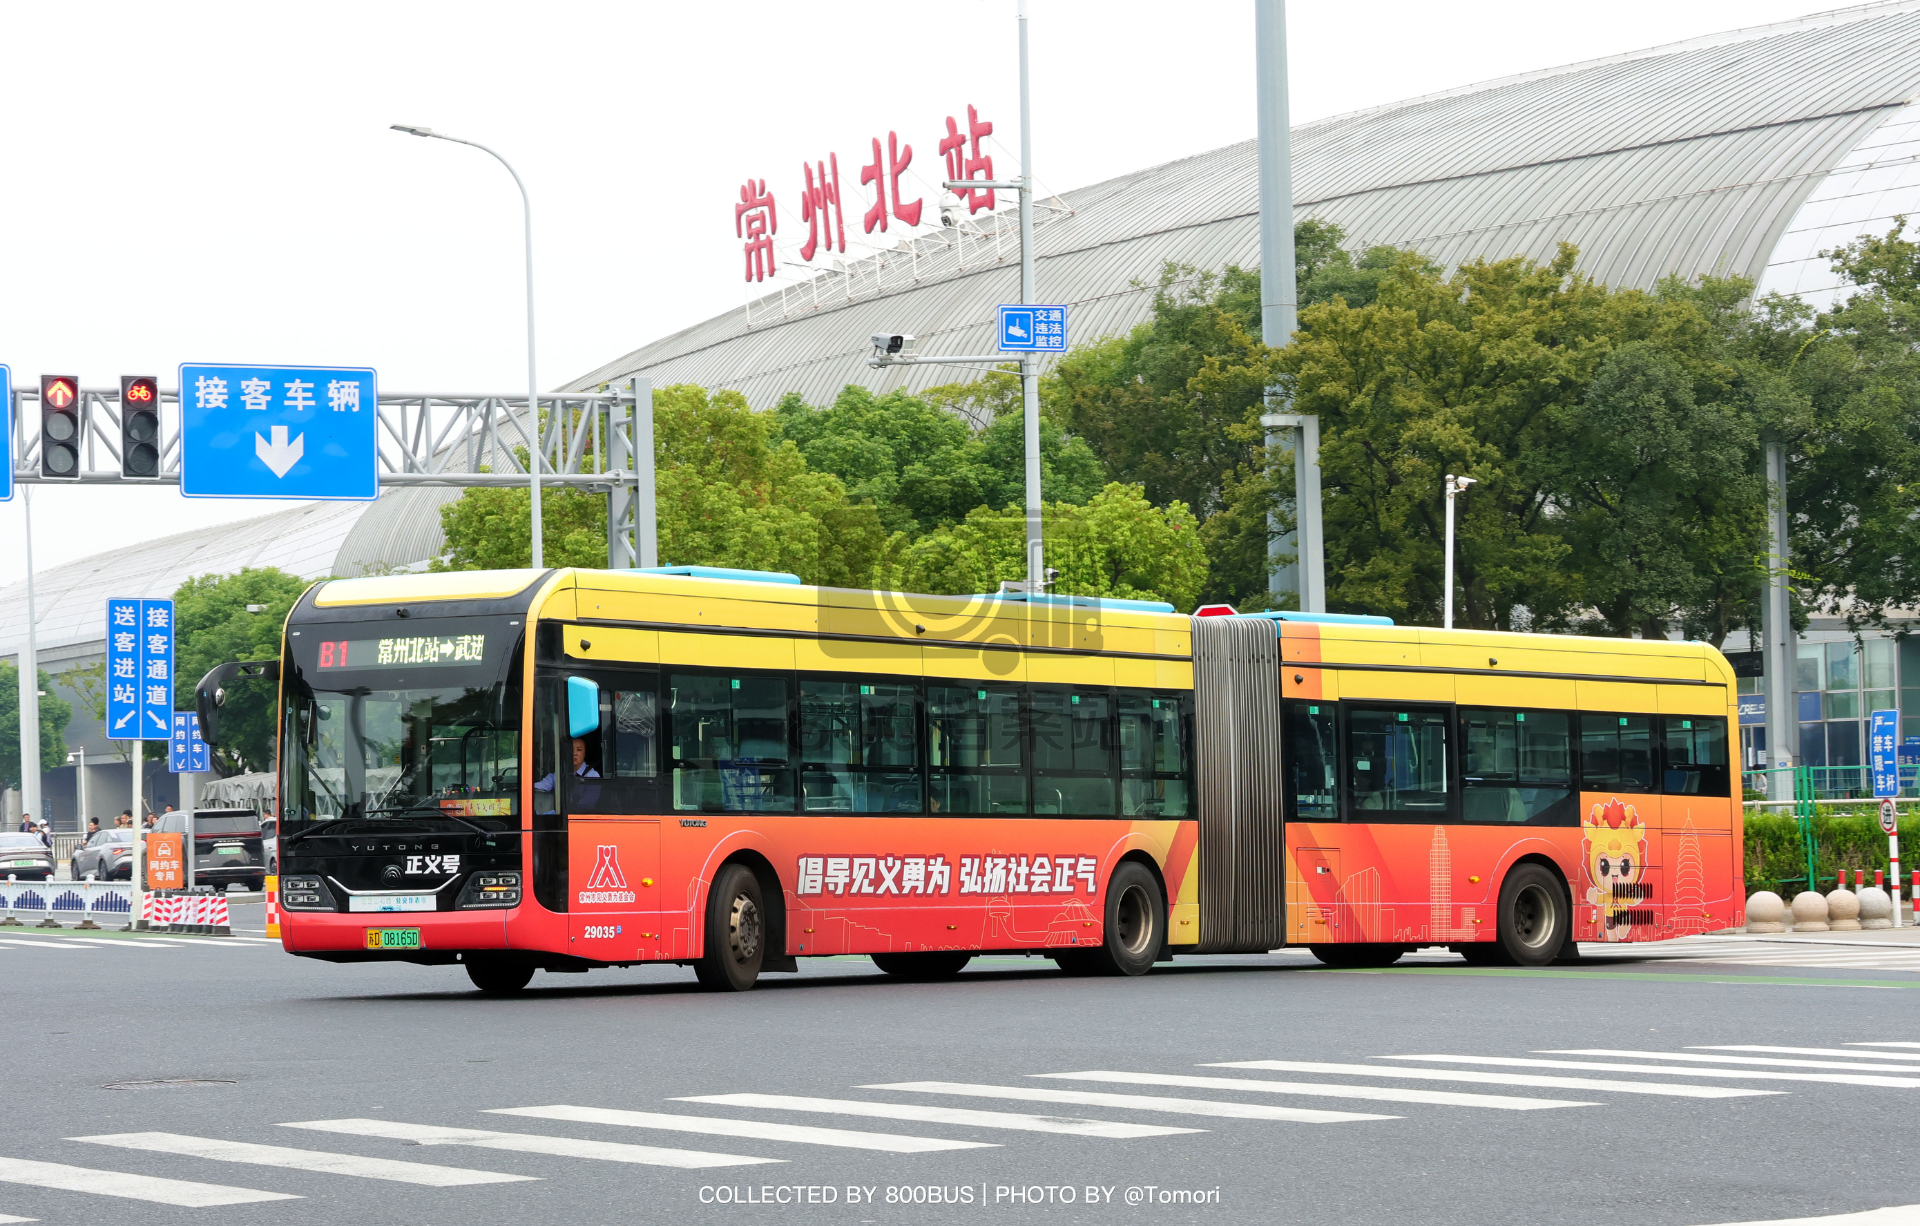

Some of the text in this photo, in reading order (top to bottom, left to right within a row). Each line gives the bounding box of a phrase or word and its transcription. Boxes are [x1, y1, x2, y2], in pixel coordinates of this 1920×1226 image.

[735, 104, 995, 282] 常州北站
[1035, 310, 1062, 321] 交通
[1035, 323, 1062, 334] 违法
[1035, 336, 1062, 347] 监控
[195, 375, 360, 412] 接客车辆
[113, 606, 136, 704] 送客进站
[146, 607, 169, 705] 接客通道
[320, 641, 348, 667] B1
[175, 716, 186, 754] 网约车
[1873, 716, 1885, 791] 严禁跟车
[1884, 722, 1895, 791] 一车一杆
[679, 819, 708, 828] YUTONG
[150, 861, 179, 870] 网约车
[155, 871, 174, 881] 专用
[405, 855, 460, 874] 正义号
[797, 856, 1098, 894] 倡导见义勇为 弘扬社会正气
[584, 926, 615, 938] 29035
